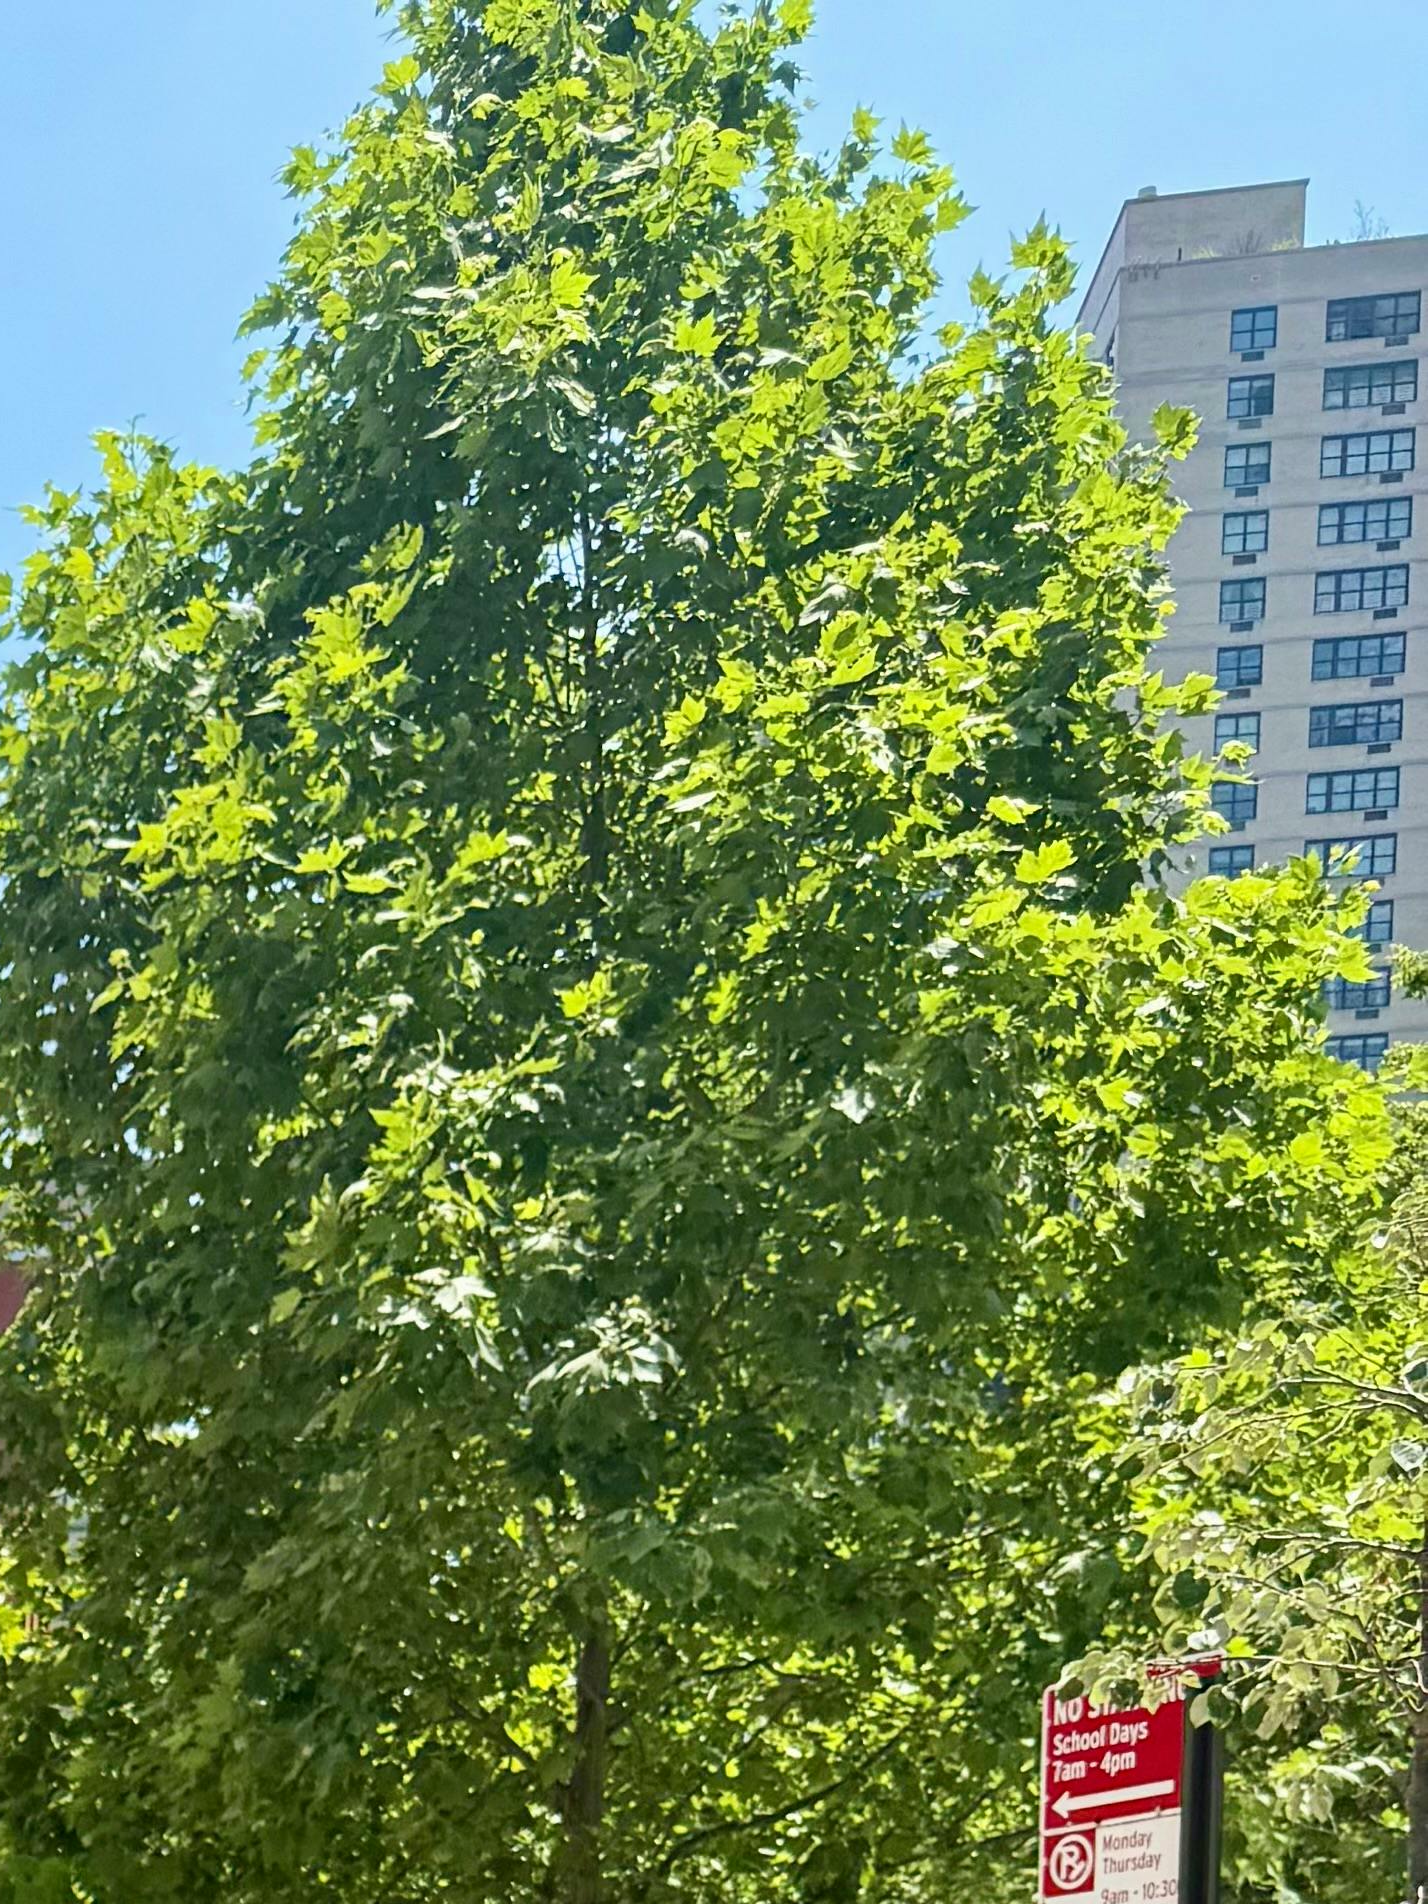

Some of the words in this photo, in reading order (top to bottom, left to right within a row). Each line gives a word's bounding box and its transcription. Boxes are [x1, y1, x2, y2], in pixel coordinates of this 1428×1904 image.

[1052, 1724, 1107, 1757] School
[1109, 1721, 1149, 1747] Days
[1052, 1760, 1086, 1783] 7am
[1099, 1750, 1136, 1778] 4pm
[1102, 1830, 1153, 1852] Monday
[1103, 1852, 1162, 1875] Thursday
